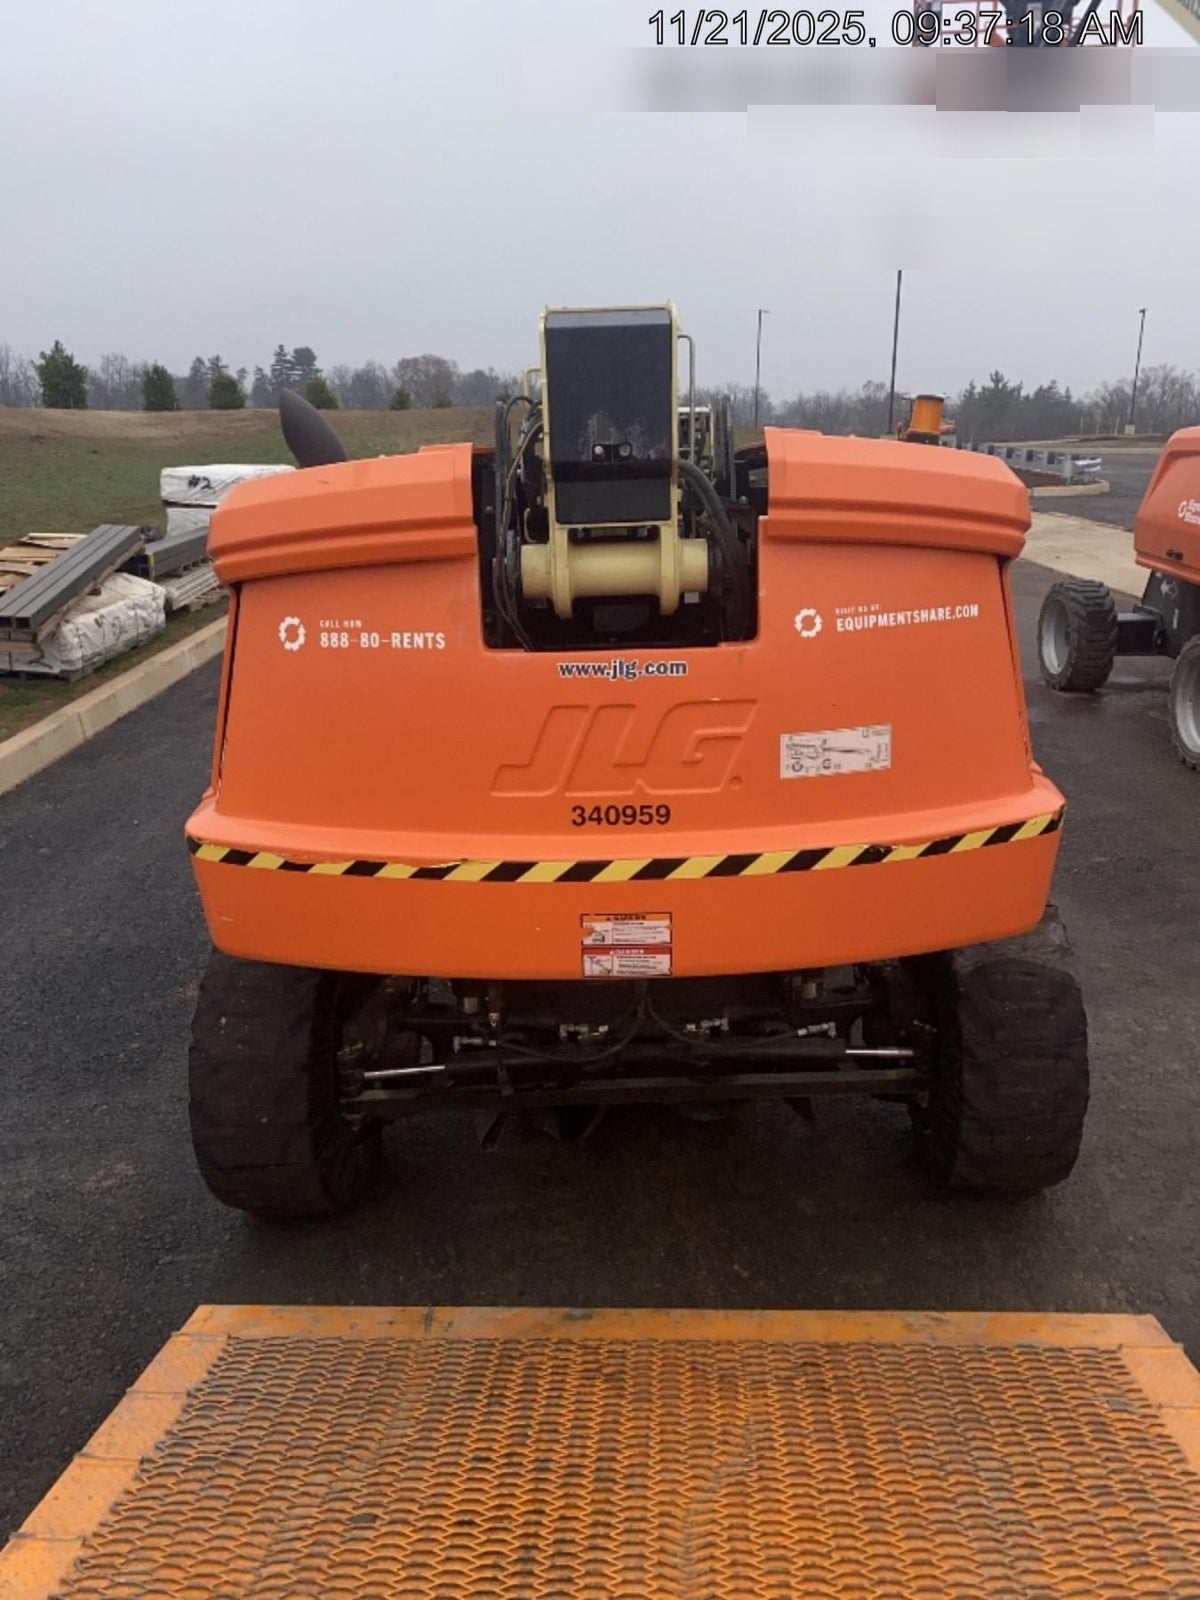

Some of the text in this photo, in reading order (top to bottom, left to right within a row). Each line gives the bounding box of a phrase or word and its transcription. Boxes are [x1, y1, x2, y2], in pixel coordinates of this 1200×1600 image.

[836, 603, 980, 632] EQUIPMENTSHARE.COM
[320, 631, 446, 650] 888-80-RENTS
[558, 659, 689, 681] www.jlg.com
[571, 804, 672, 827] 340959
